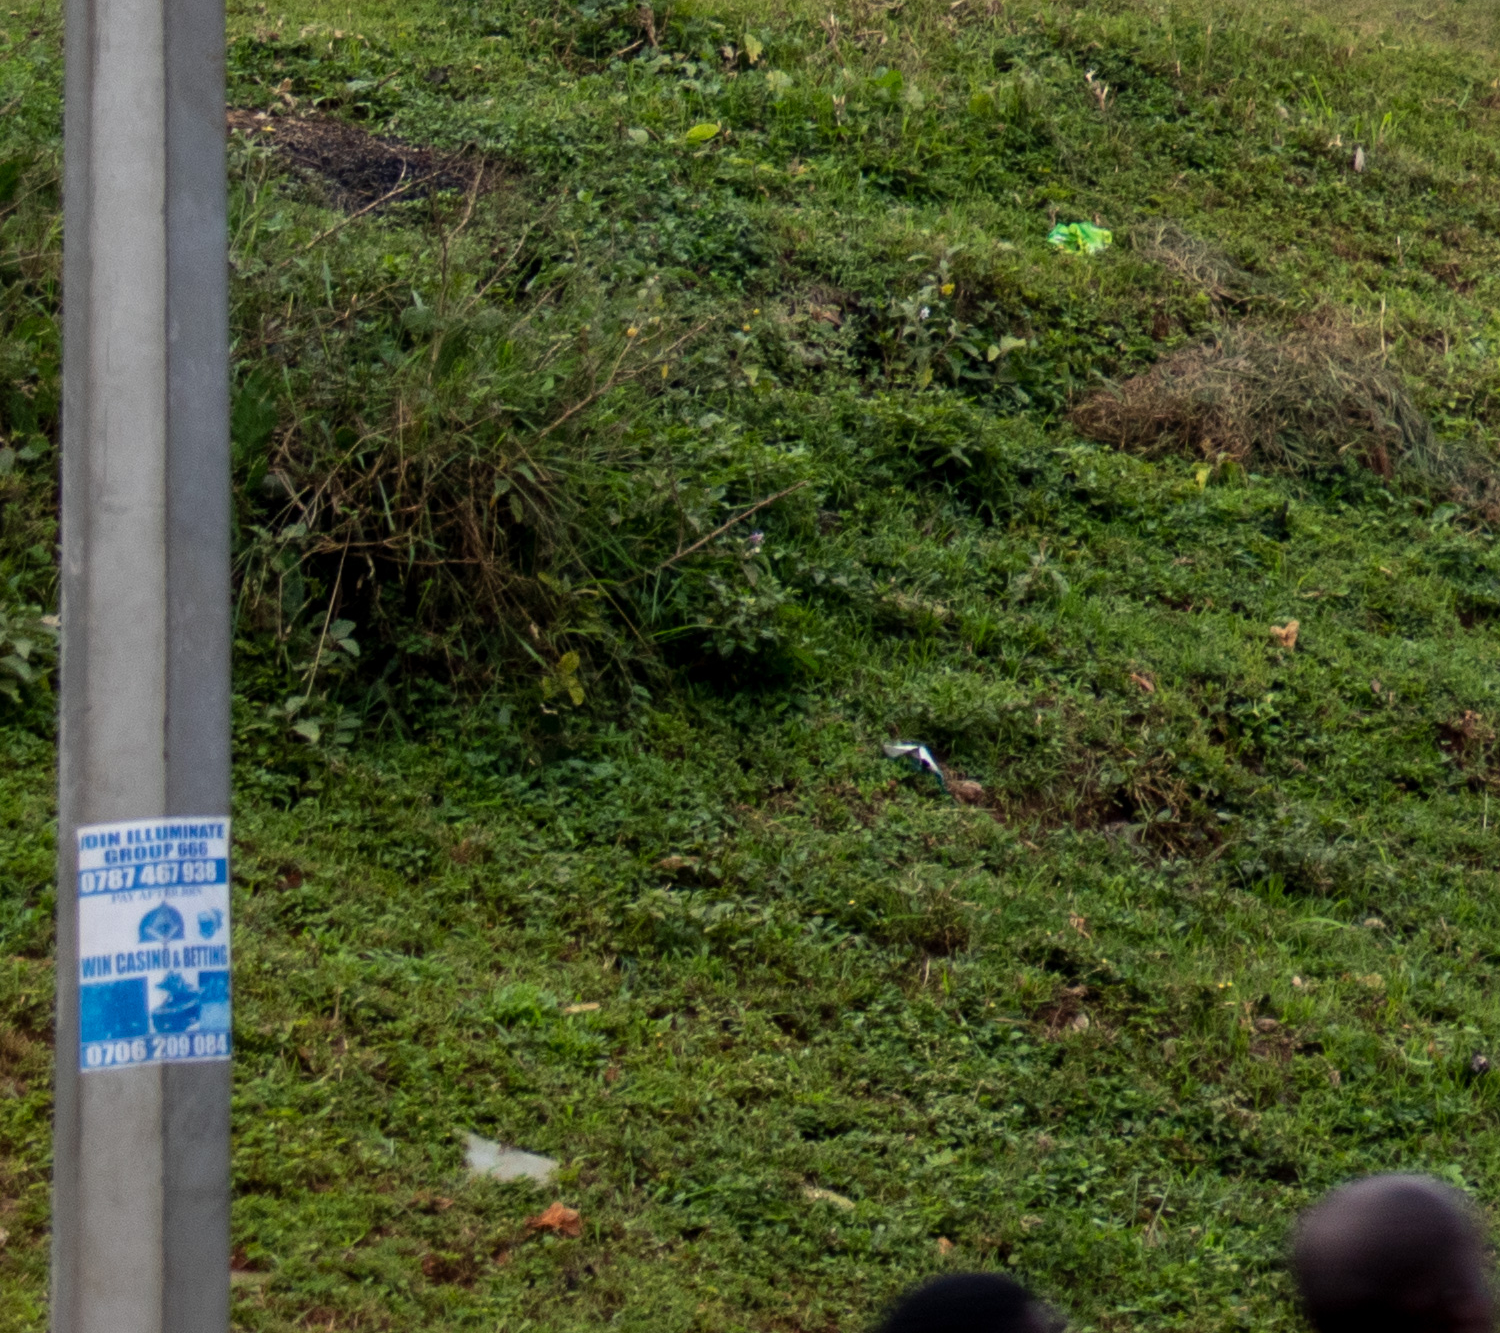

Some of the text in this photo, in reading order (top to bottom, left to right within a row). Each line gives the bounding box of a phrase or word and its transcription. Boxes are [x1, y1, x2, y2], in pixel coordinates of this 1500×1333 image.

[127, 823, 226, 845] ILLUMINATE
[104, 843, 174, 864] GROUP
[80, 865, 136, 894] 0787
[81, 953, 113, 979] WIN
[115, 948, 171, 975] CASINO
[183, 944, 228, 968] BETTING
[86, 1036, 148, 1066] 0706
